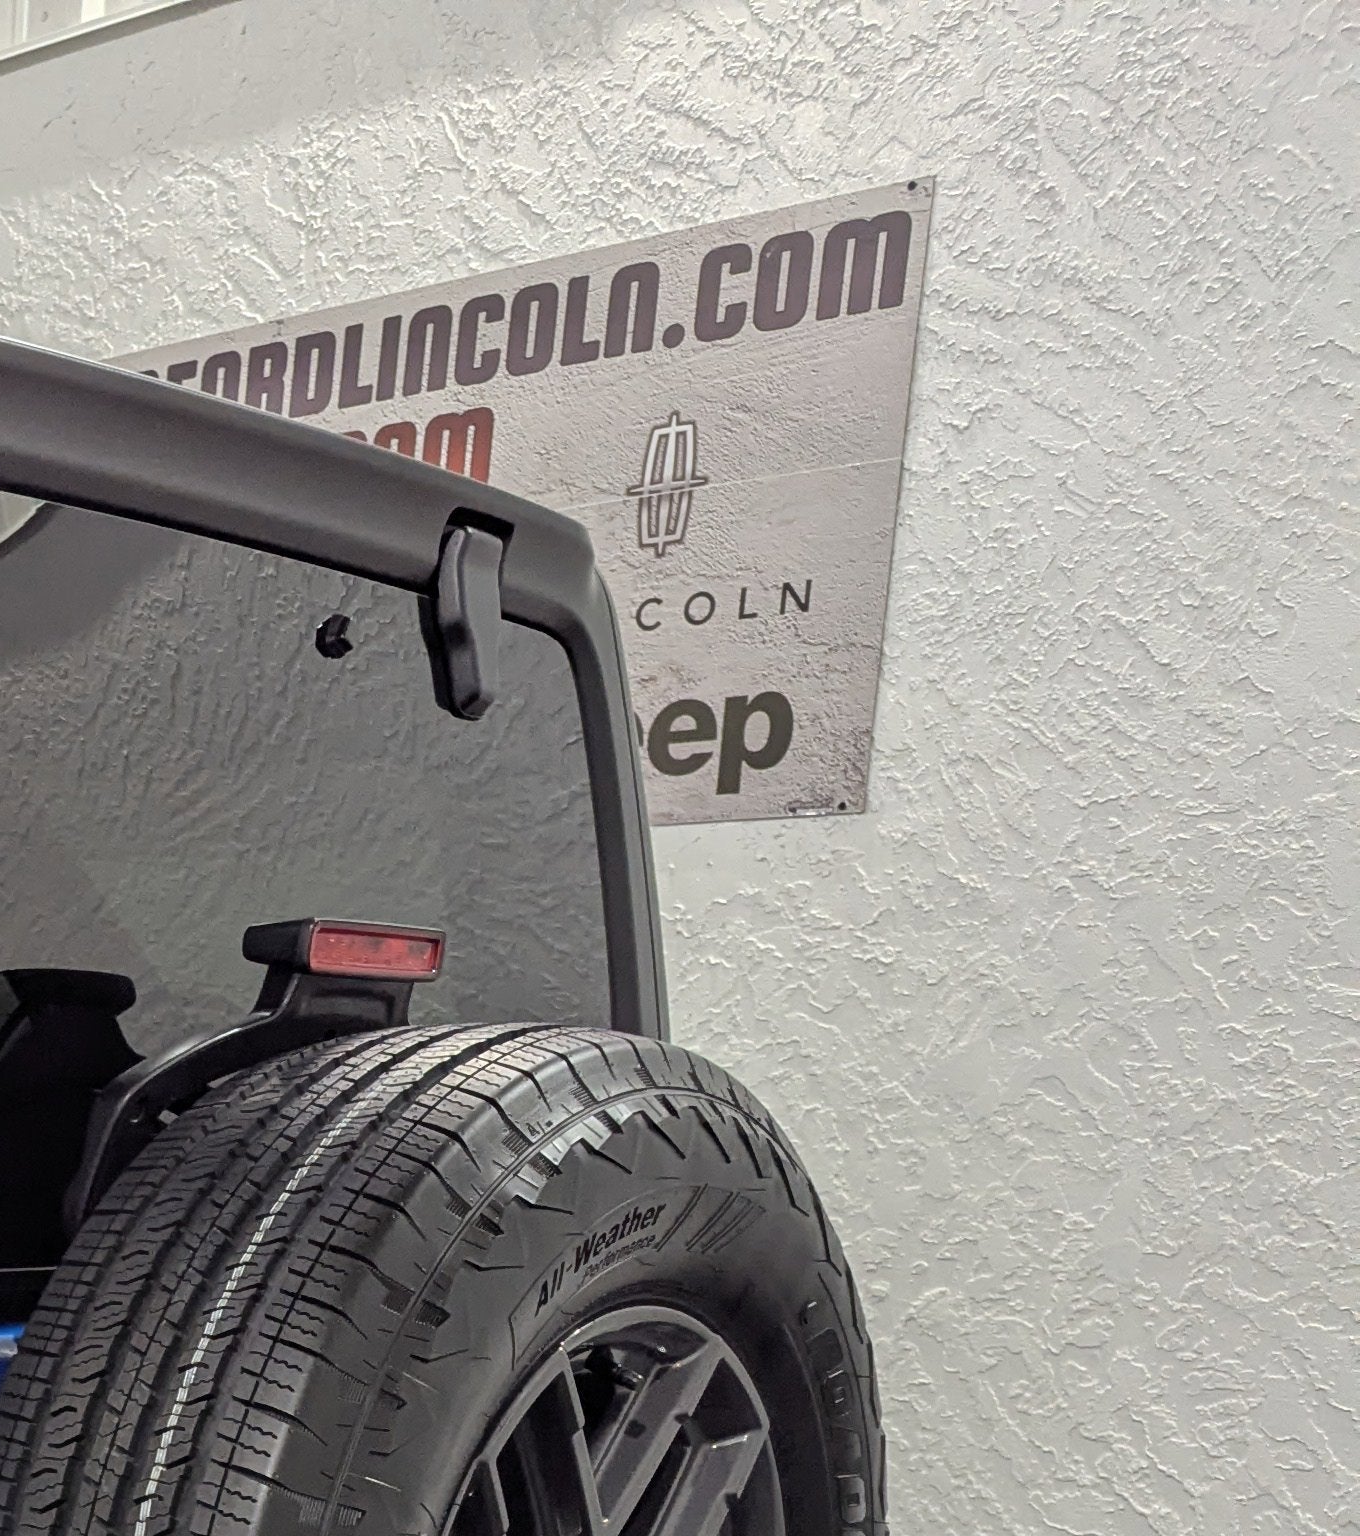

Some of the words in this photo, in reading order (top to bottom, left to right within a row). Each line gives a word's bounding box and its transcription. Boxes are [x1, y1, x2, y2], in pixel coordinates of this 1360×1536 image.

[635, 579, 813, 632] COLN
[634, 690, 794, 795] ep
[534, 1202, 667, 1316] All-Weather
